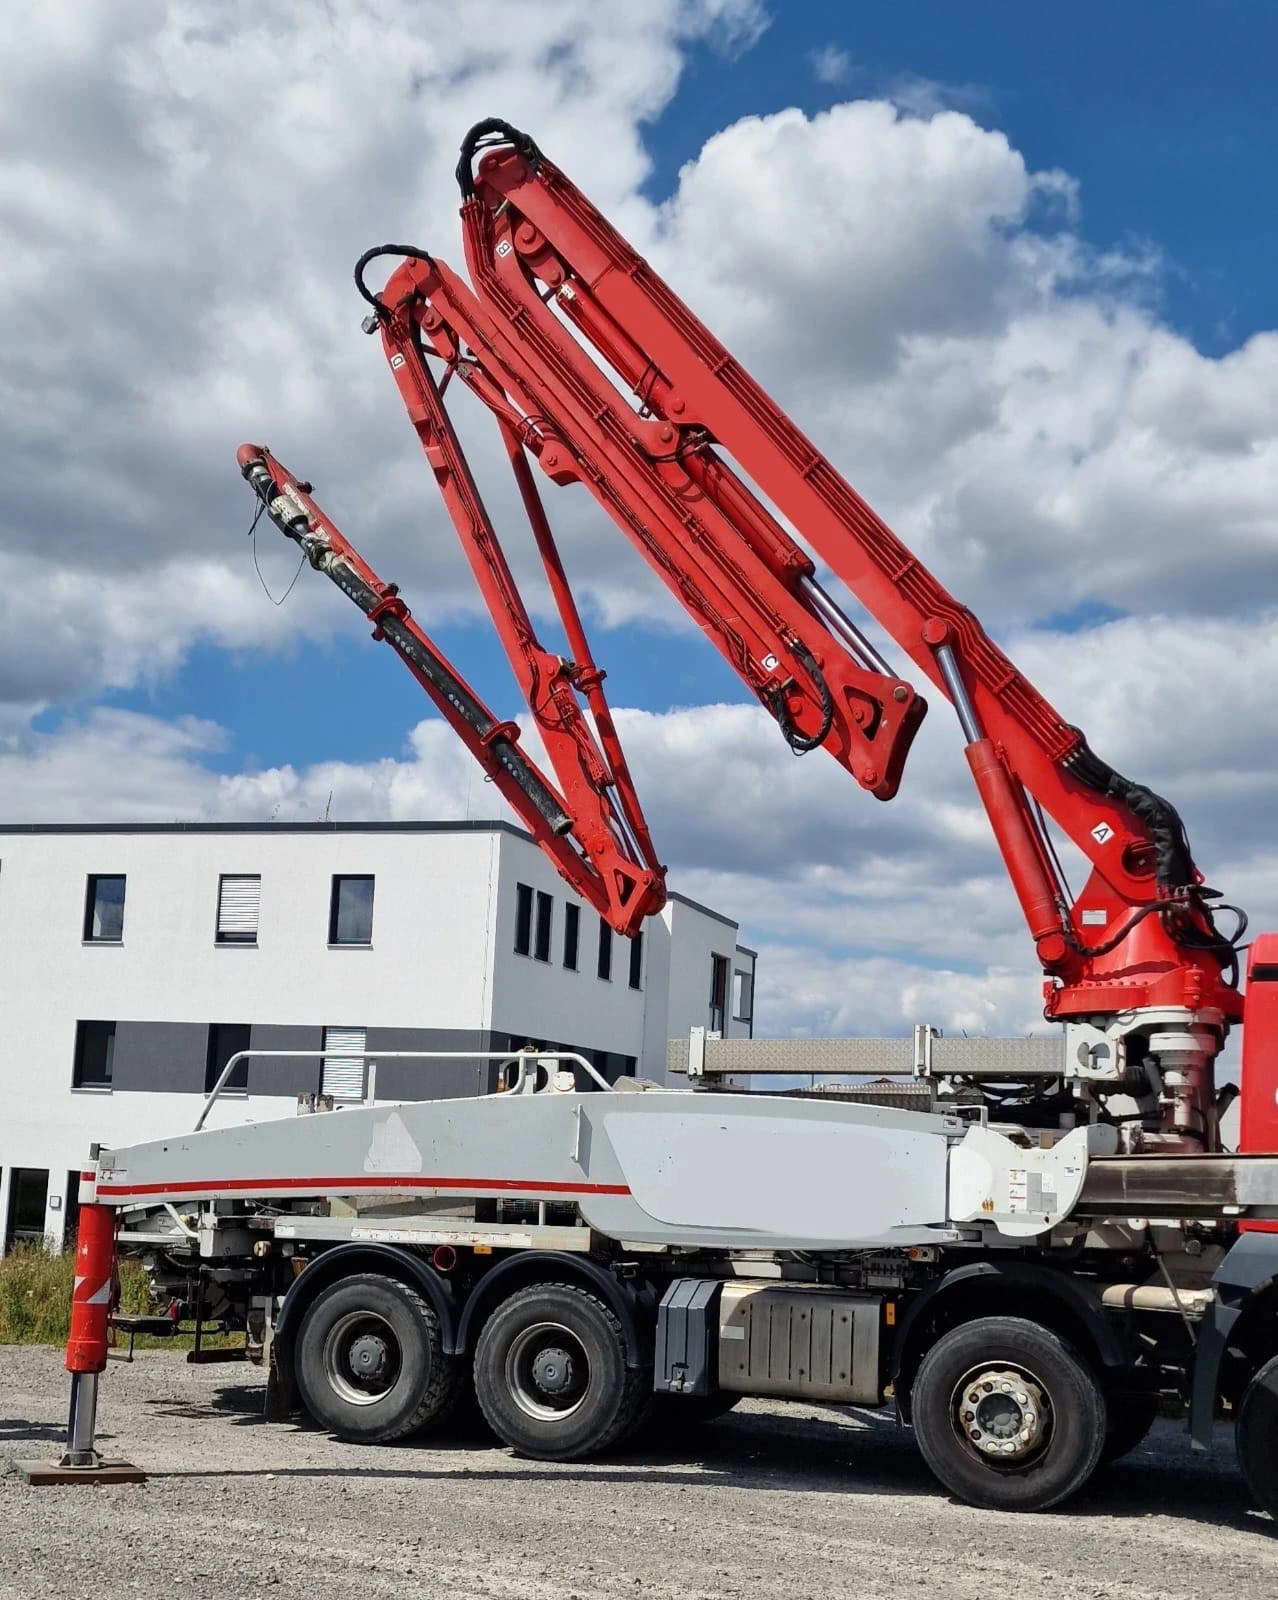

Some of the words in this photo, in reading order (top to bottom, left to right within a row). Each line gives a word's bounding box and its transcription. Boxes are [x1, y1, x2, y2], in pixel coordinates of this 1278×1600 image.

[498, 242, 511, 255] B
[392, 355, 404, 367] D
[765, 655, 777, 669] C
[1093, 827, 1109, 842] A
